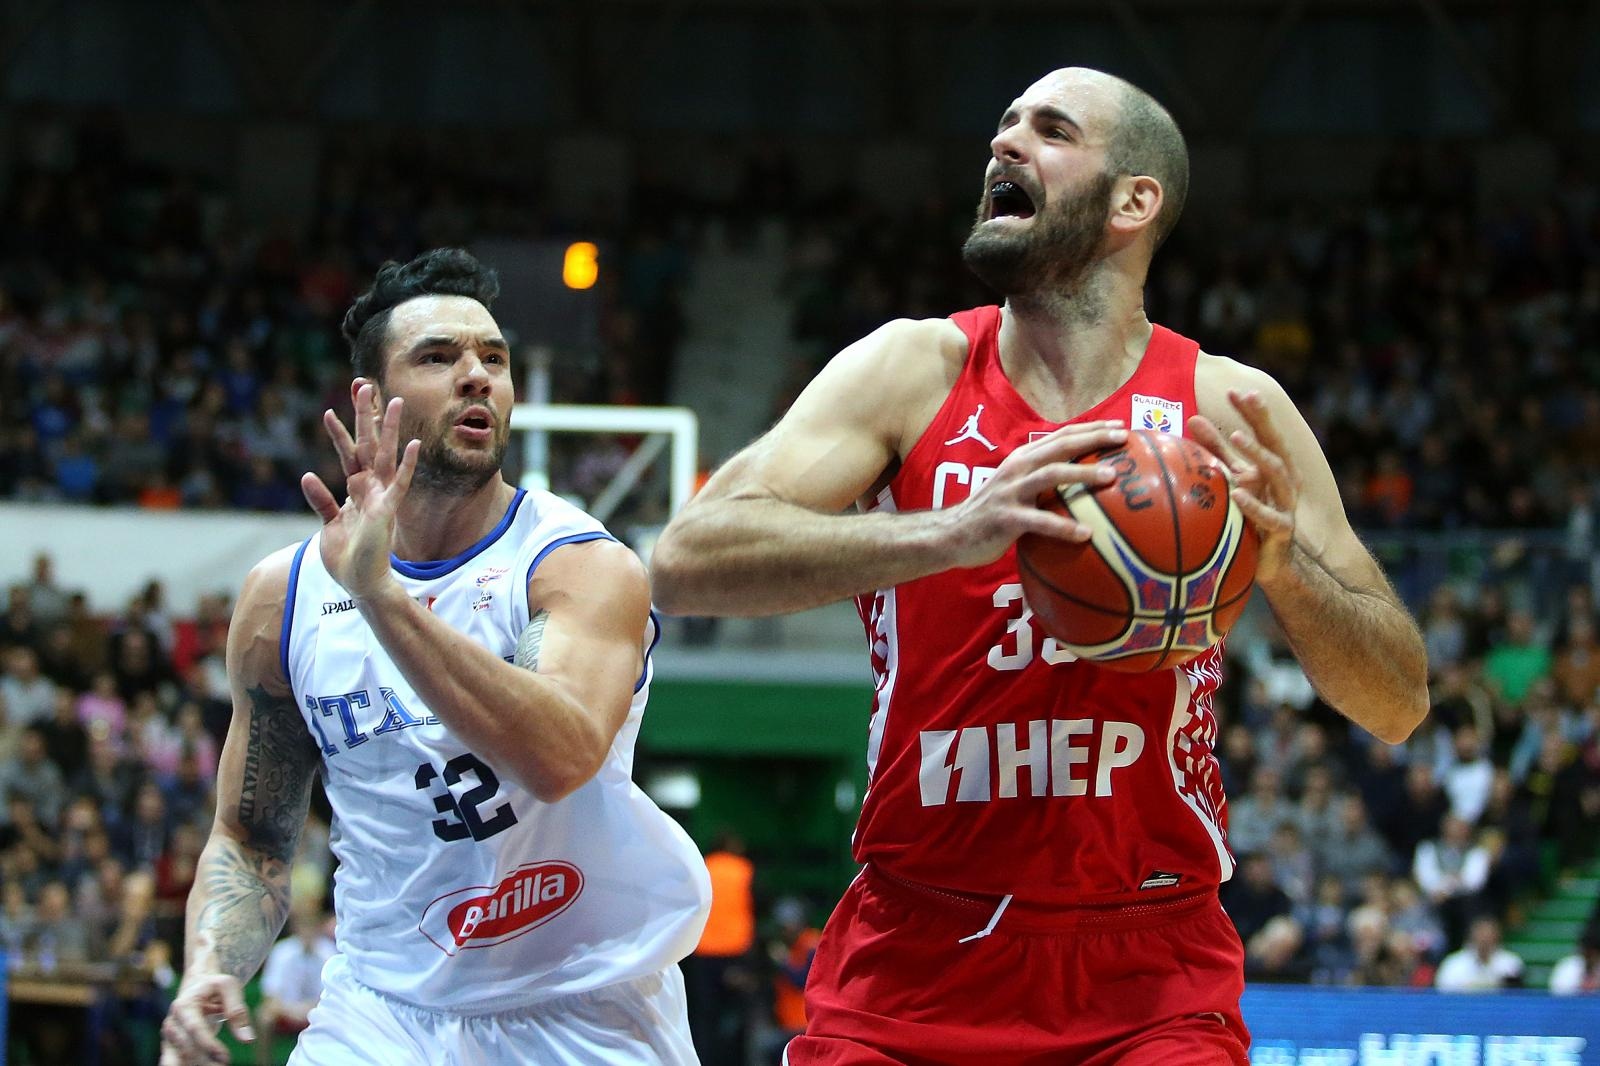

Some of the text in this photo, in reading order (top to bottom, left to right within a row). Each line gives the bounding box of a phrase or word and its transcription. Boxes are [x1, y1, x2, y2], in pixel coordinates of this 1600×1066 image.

[321, 599, 357, 617] SPAL
[987, 583, 1080, 671] 3
[305, 686, 441, 757] ITA
[996, 718, 1145, 799] HEP
[414, 752, 518, 842] 32
[458, 872, 567, 938] Barilla
